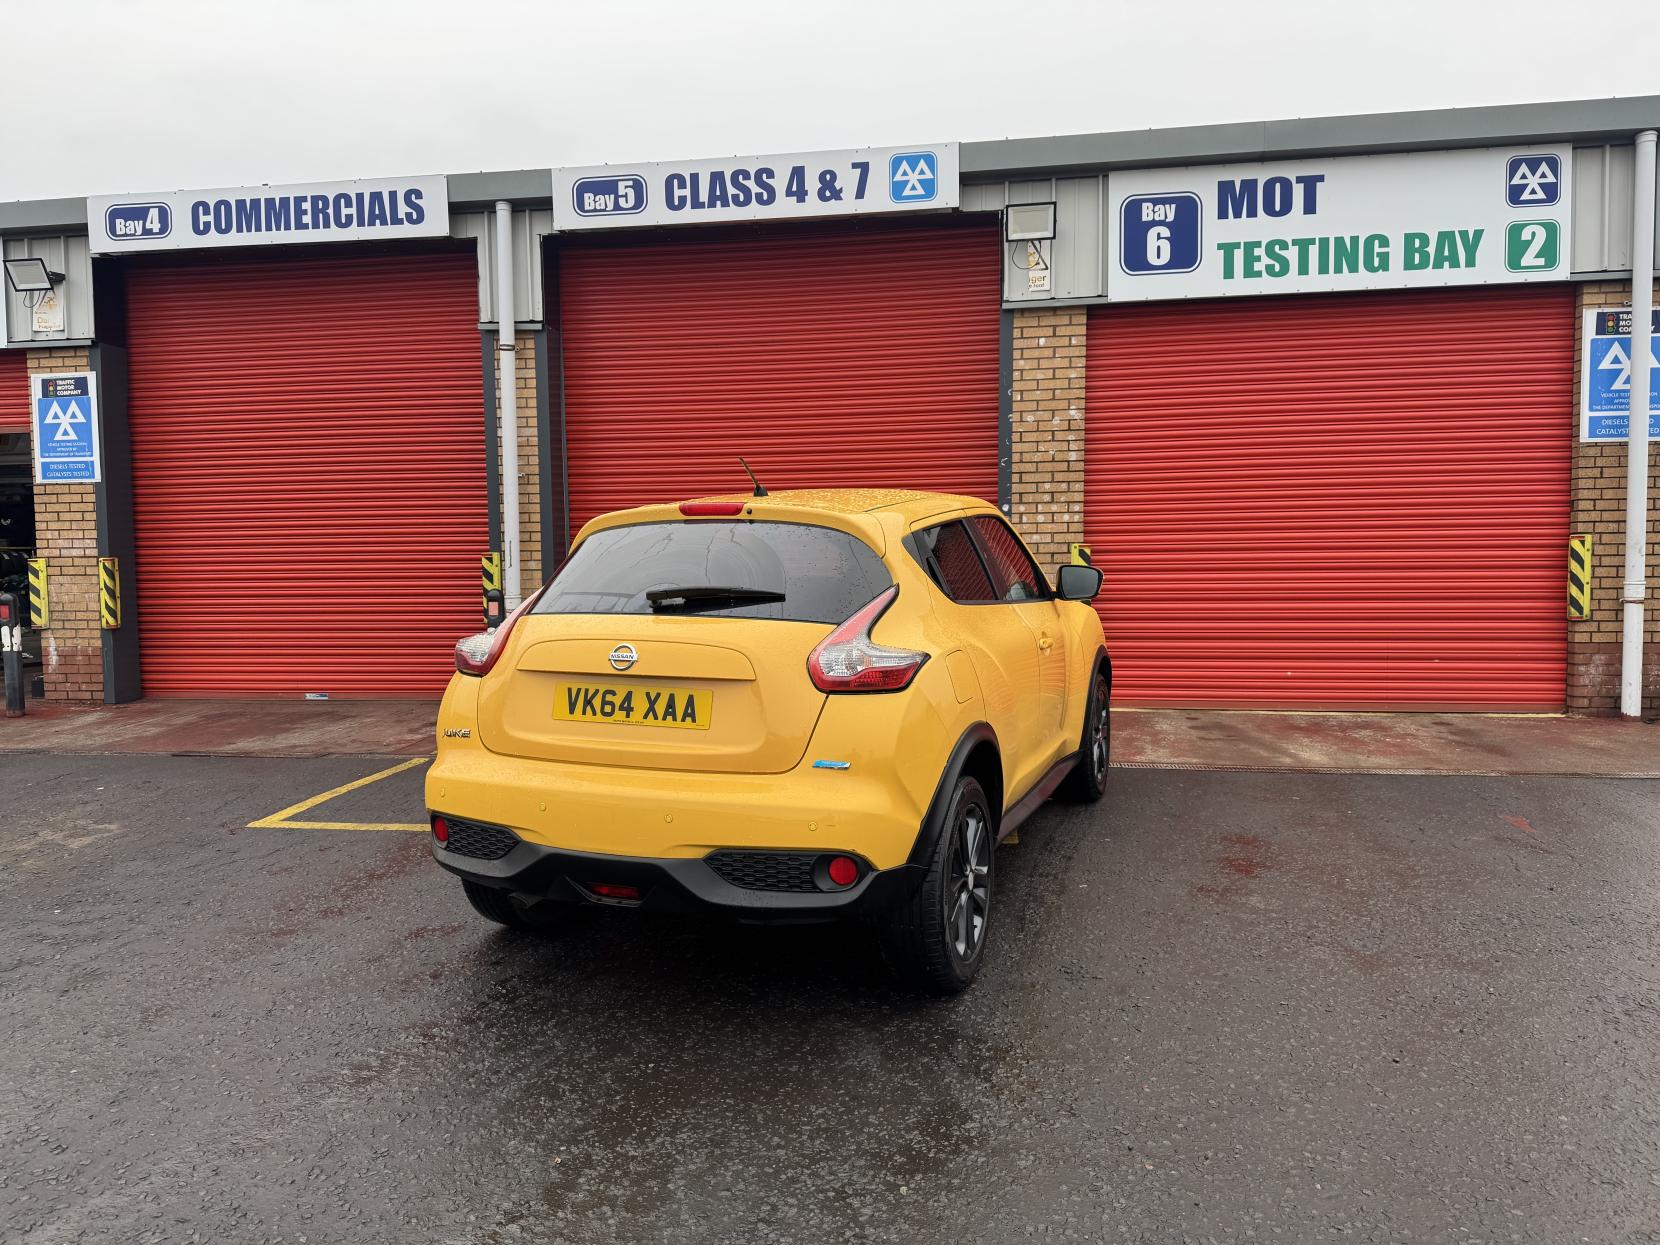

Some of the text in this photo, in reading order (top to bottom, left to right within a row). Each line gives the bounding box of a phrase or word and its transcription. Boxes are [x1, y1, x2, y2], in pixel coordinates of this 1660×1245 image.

[584, 181, 635, 212] Bay 5
[664, 161, 870, 212] CLASS 4 & 7
[1217, 174, 1325, 220] MOT
[115, 208, 161, 236] Bay 4
[191, 188, 425, 236] COMMERCIALS
[1141, 202, 1176, 224] Bay
[1146, 225, 1171, 266] 6
[1217, 228, 1485, 281] TESTING BAY
[1521, 224, 1547, 267] 2
[1596, 427, 1629, 435] CATALYST
[1601, 418, 1628, 426] DIESELS
[567, 687, 697, 724] VK64 XAA
[441, 728, 471, 738] JUKE
